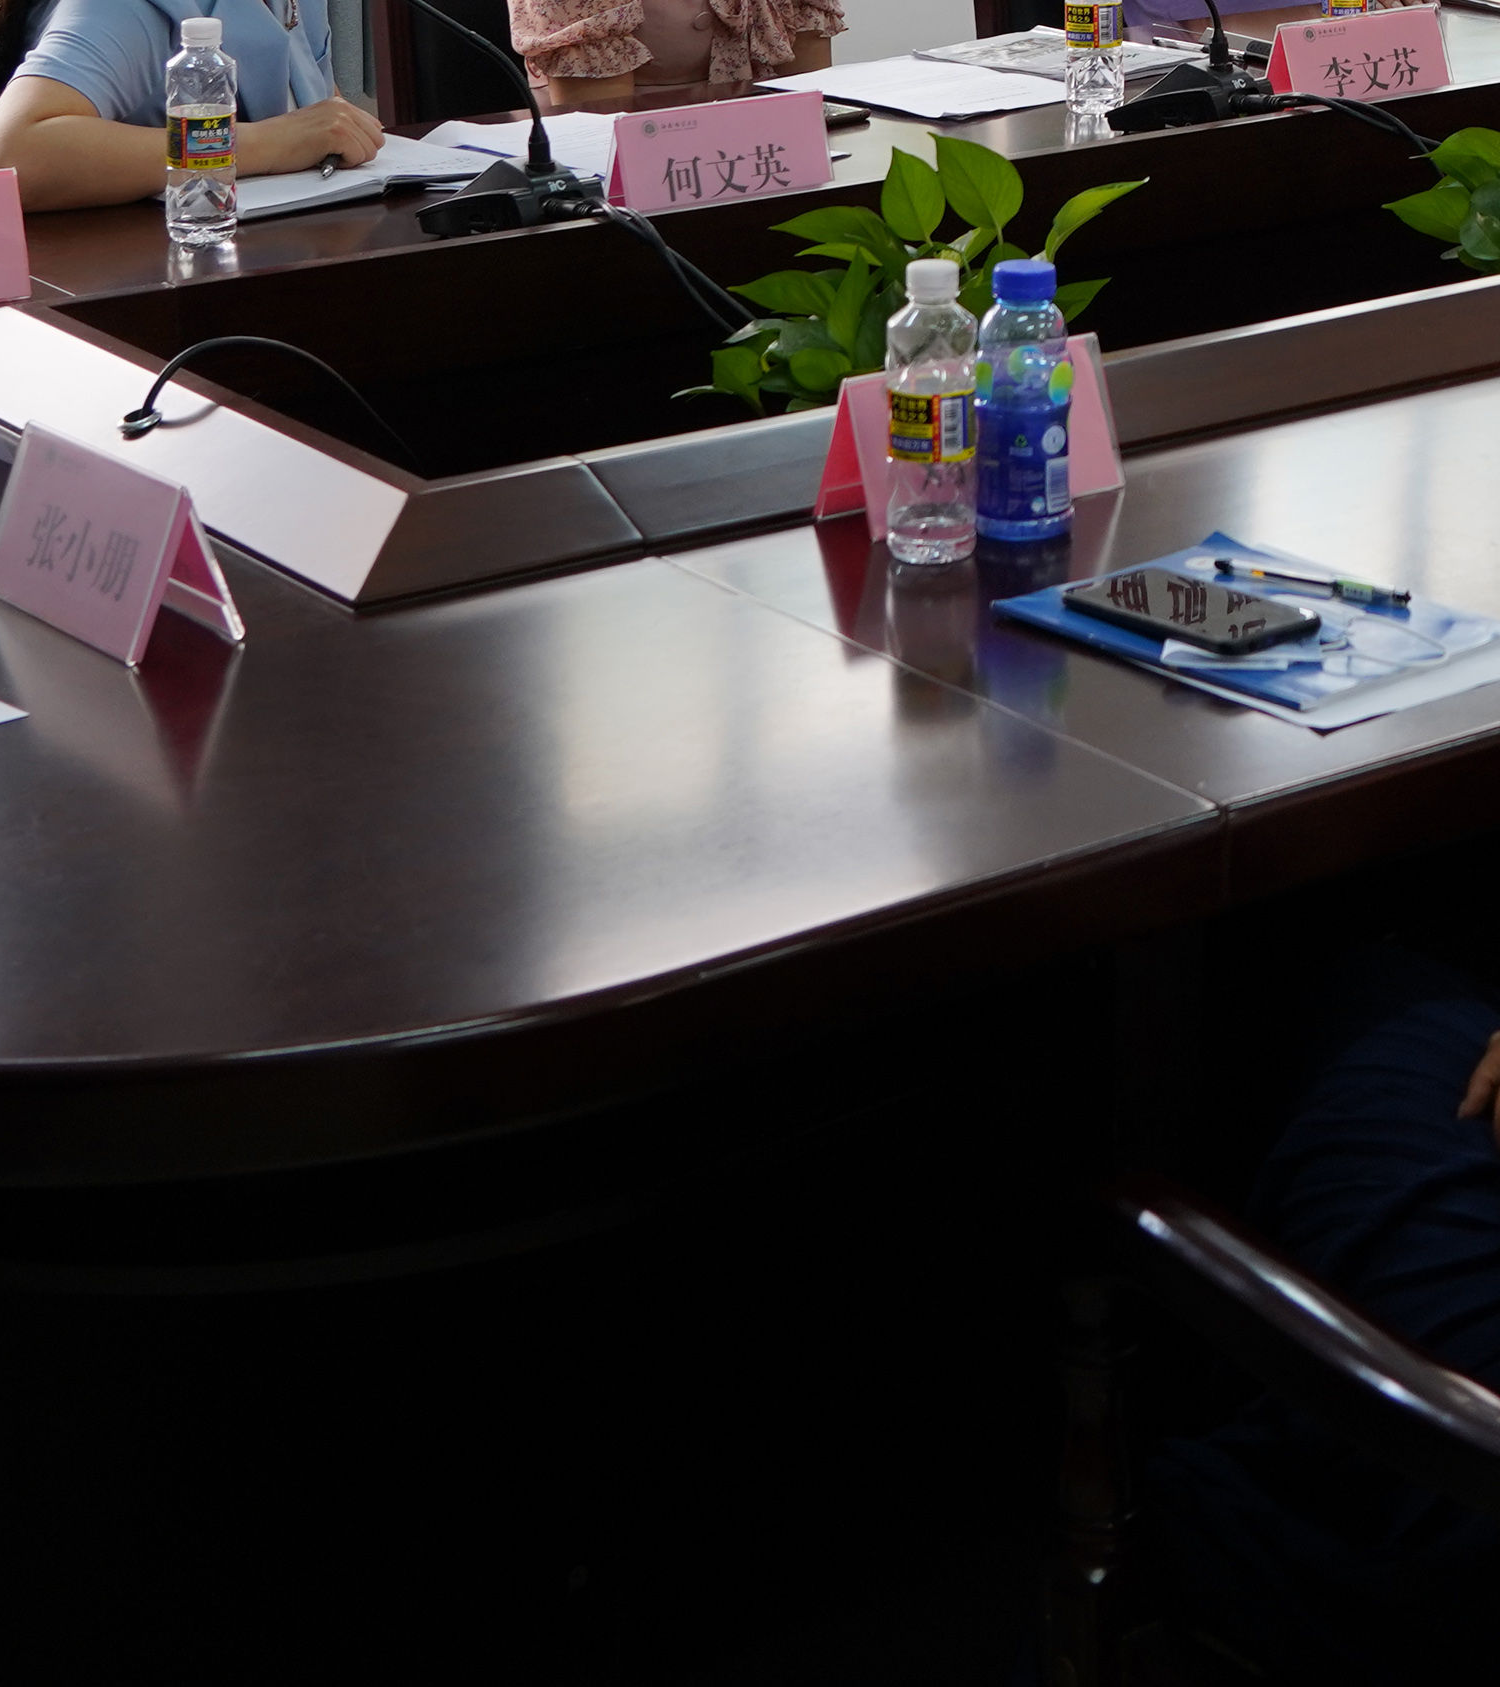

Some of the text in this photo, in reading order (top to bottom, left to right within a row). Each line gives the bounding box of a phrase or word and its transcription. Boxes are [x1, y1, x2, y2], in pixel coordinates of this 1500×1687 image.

[1320, 47, 1420, 97] 李文芬
[662, 143, 791, 202] 何文英
[27, 503, 140, 603] 张小朋
